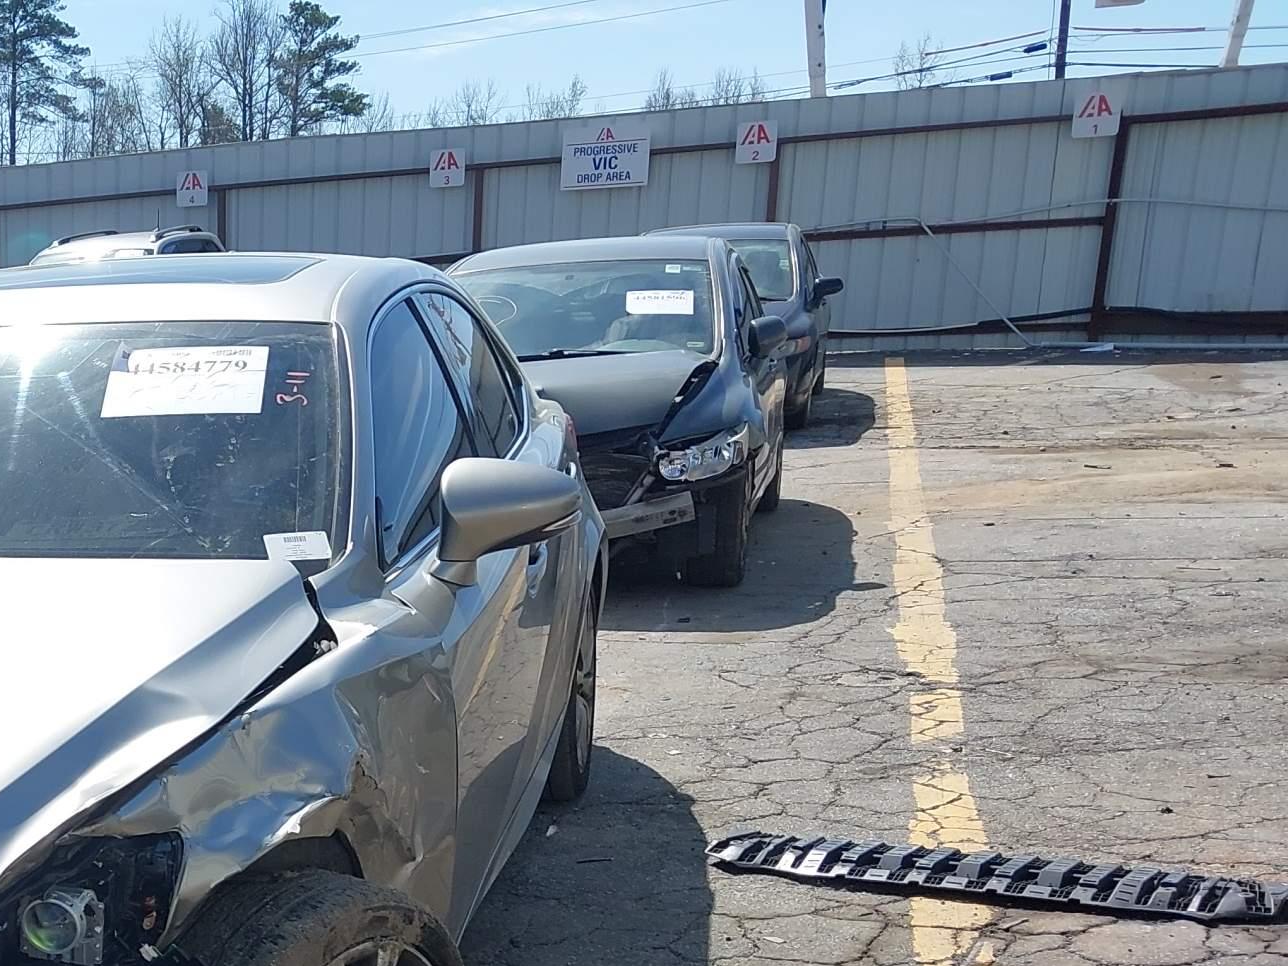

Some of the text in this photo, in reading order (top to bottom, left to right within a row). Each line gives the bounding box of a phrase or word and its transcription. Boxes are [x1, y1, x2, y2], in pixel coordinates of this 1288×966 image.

[1093, 124, 1098, 135] 1
[573, 143, 639, 157] PROGRESSIVE
[752, 150, 760, 161] 2
[592, 156, 618, 171] VIC
[444, 175, 450, 185] 3
[576, 170, 631, 184] DROP AREA
[189, 195, 195, 204] 4
